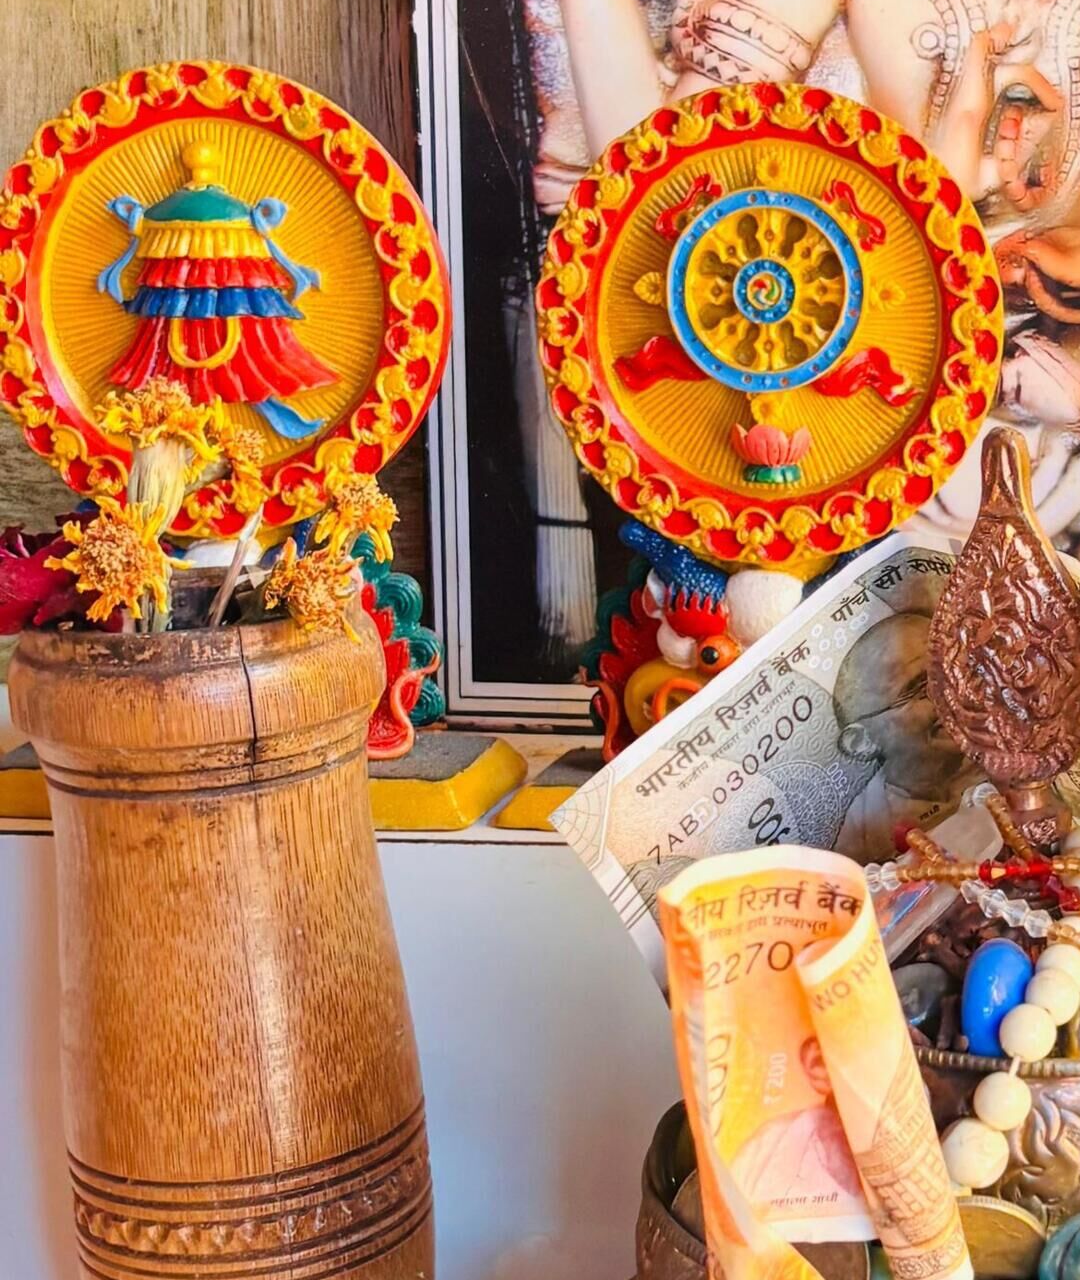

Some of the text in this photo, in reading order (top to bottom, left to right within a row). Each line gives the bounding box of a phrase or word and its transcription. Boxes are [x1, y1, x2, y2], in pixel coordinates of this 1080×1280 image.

[872, 564, 903, 590] सौ
[635, 639, 811, 797] भारतीय रिज़र्व बैंक
[738, 881, 810, 917] रिज़र्व
[706, 939, 814, 990] 2270
